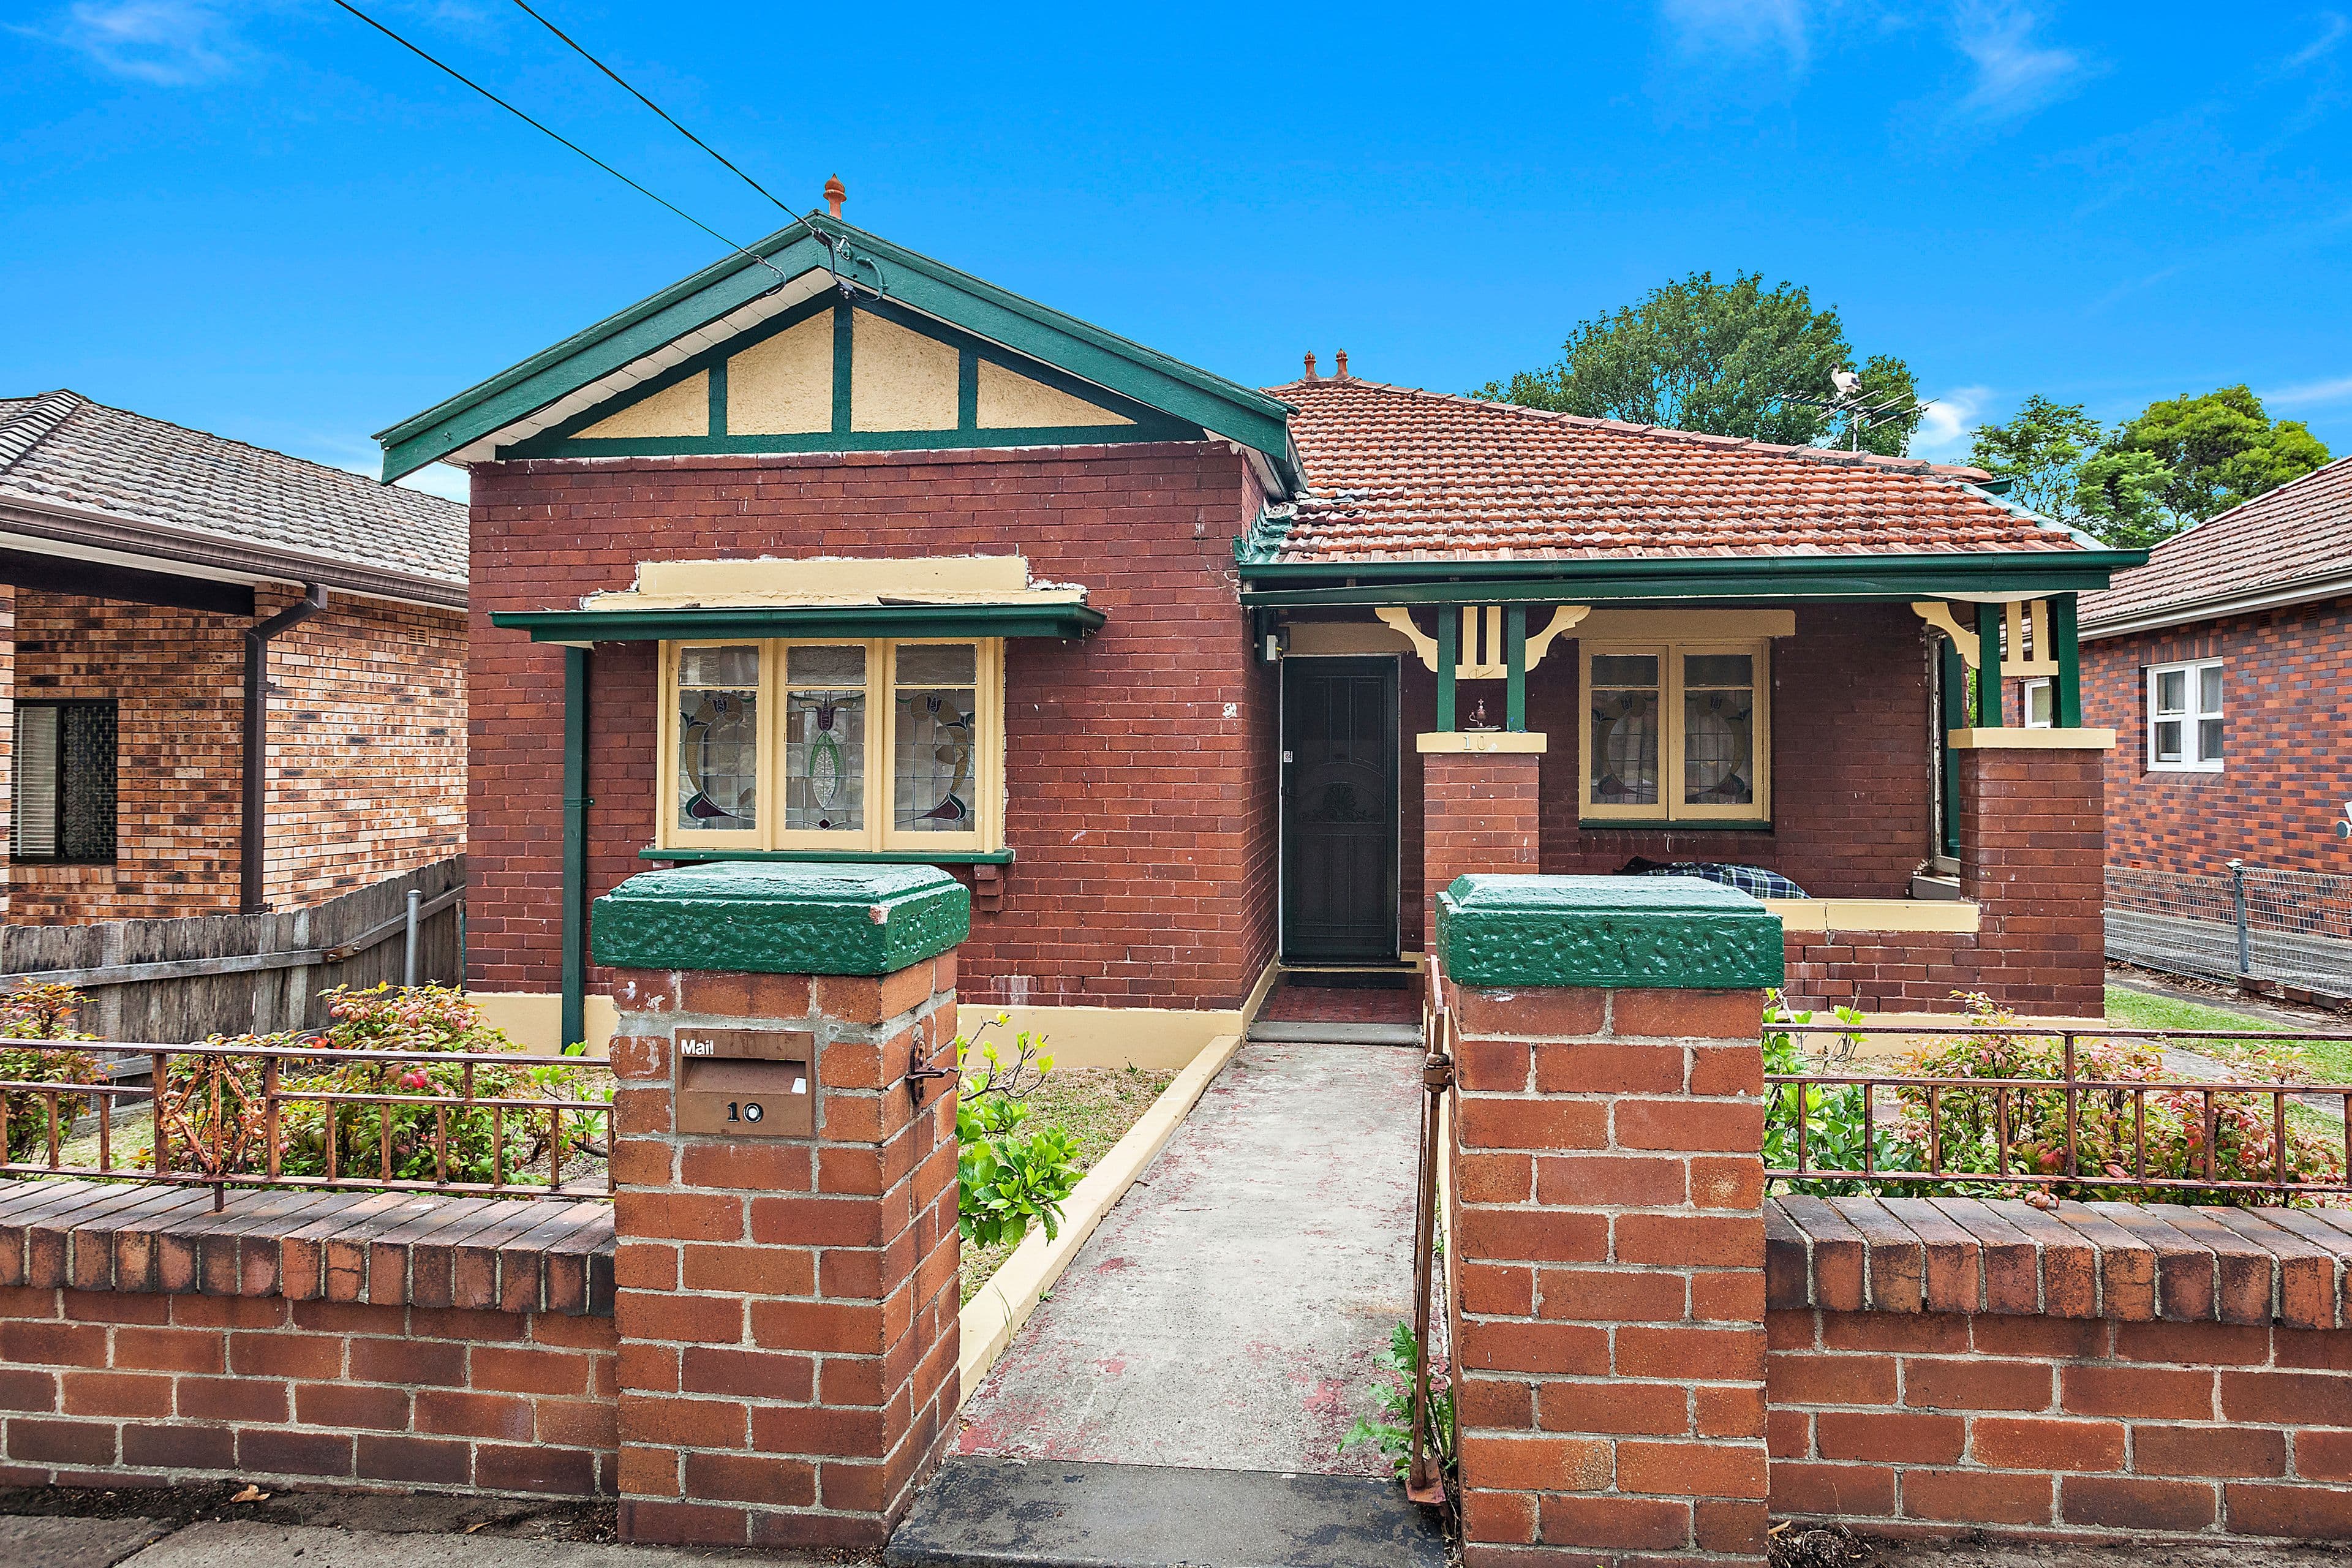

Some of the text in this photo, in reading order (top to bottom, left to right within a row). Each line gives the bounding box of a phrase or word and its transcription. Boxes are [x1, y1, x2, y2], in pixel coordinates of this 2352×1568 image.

[1463, 735, 1485, 750] 10
[681, 1039, 714, 1055] Mail
[727, 1101, 763, 1123] 10
